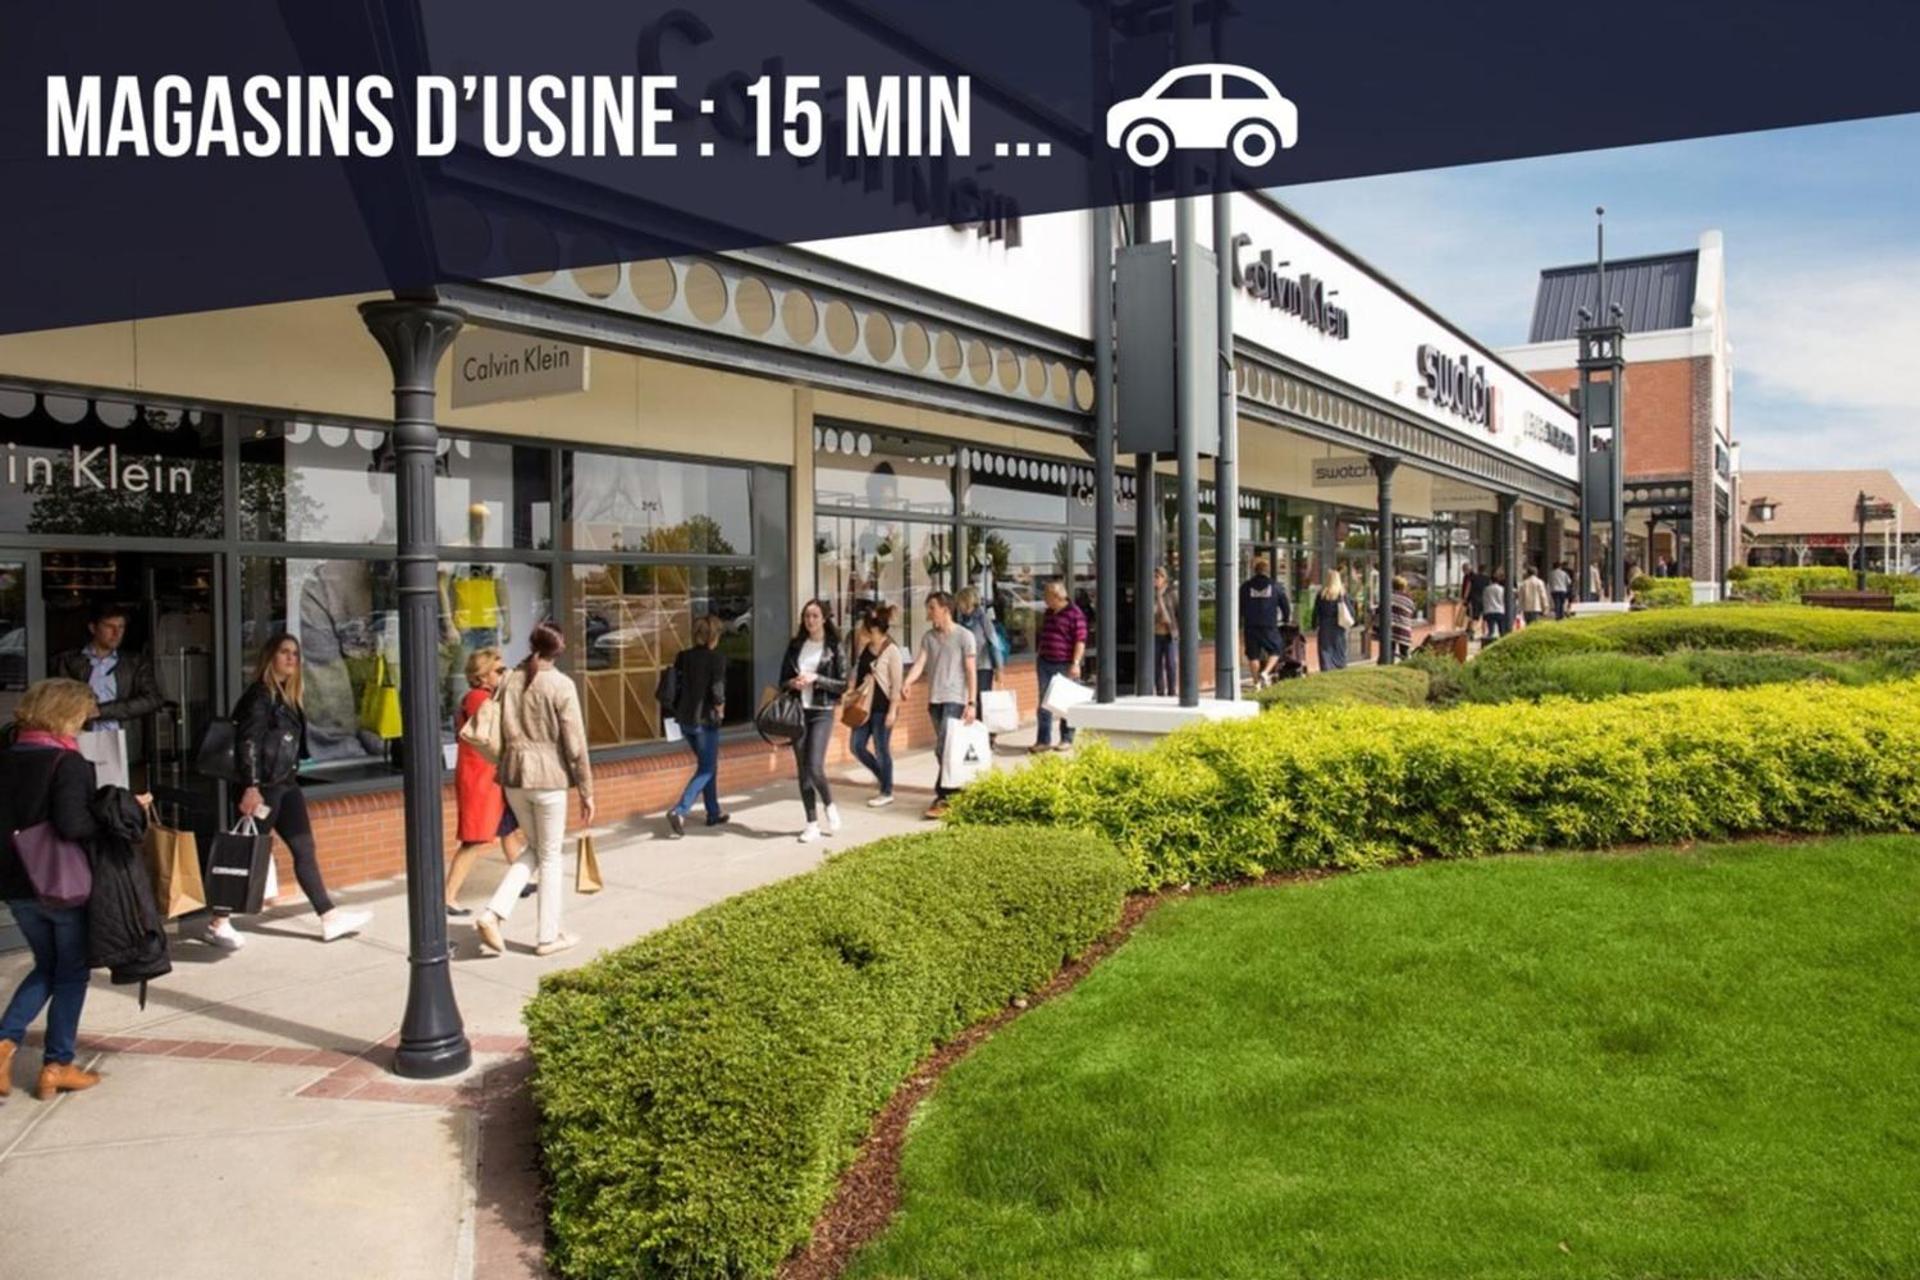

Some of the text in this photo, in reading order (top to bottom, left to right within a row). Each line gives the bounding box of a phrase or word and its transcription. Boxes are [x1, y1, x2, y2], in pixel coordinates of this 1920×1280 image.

[463, 344, 569, 382] Calvin Klein
[72, 443, 192, 495] Klein
